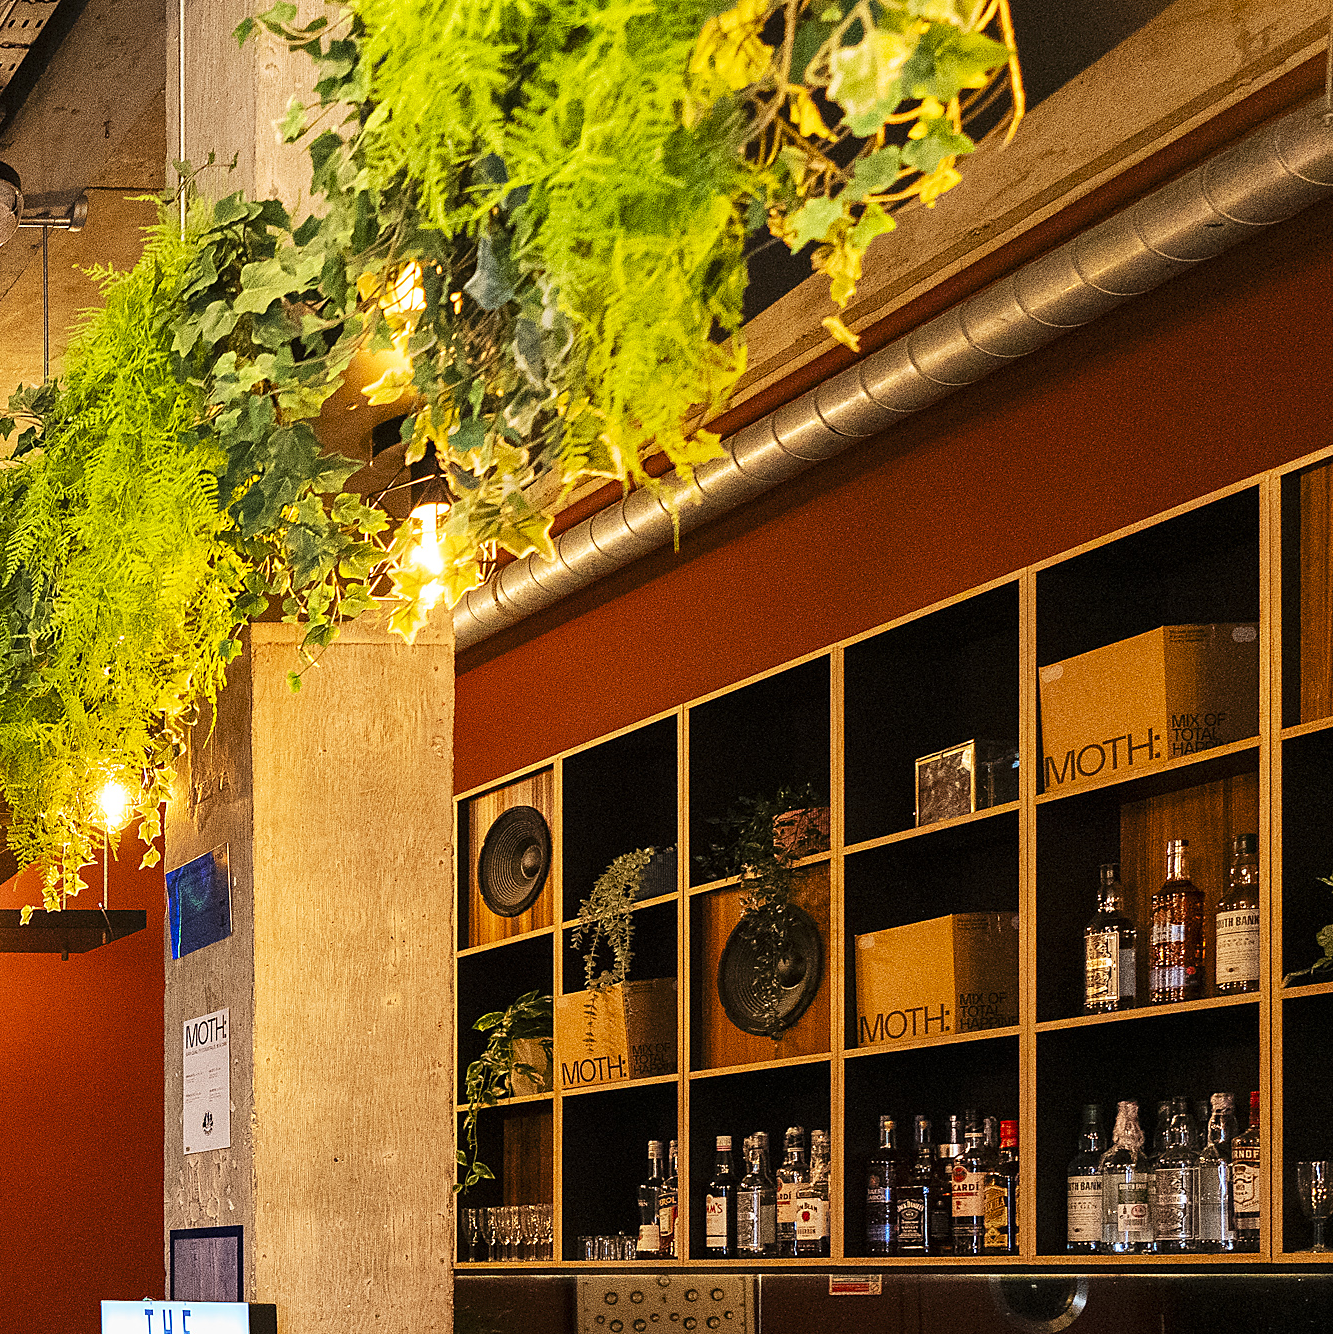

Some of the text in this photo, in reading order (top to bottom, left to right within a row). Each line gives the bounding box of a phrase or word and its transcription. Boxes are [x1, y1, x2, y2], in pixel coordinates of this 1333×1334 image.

[1171, 712, 1226, 728] MIX OF
[1172, 727, 1221, 741] TOTAL
[1044, 728, 1161, 788] MOTH:
[959, 991, 1007, 1006] MIX OF
[960, 1004, 999, 1018] TOTAL
[859, 1003, 950, 1044] MOTH:
[185, 1014, 227, 1050] MOTH:
[632, 1041, 670, 1056] MIX OF
[633, 1053, 666, 1065] TOTAL
[562, 1054, 627, 1086] MOTH:
